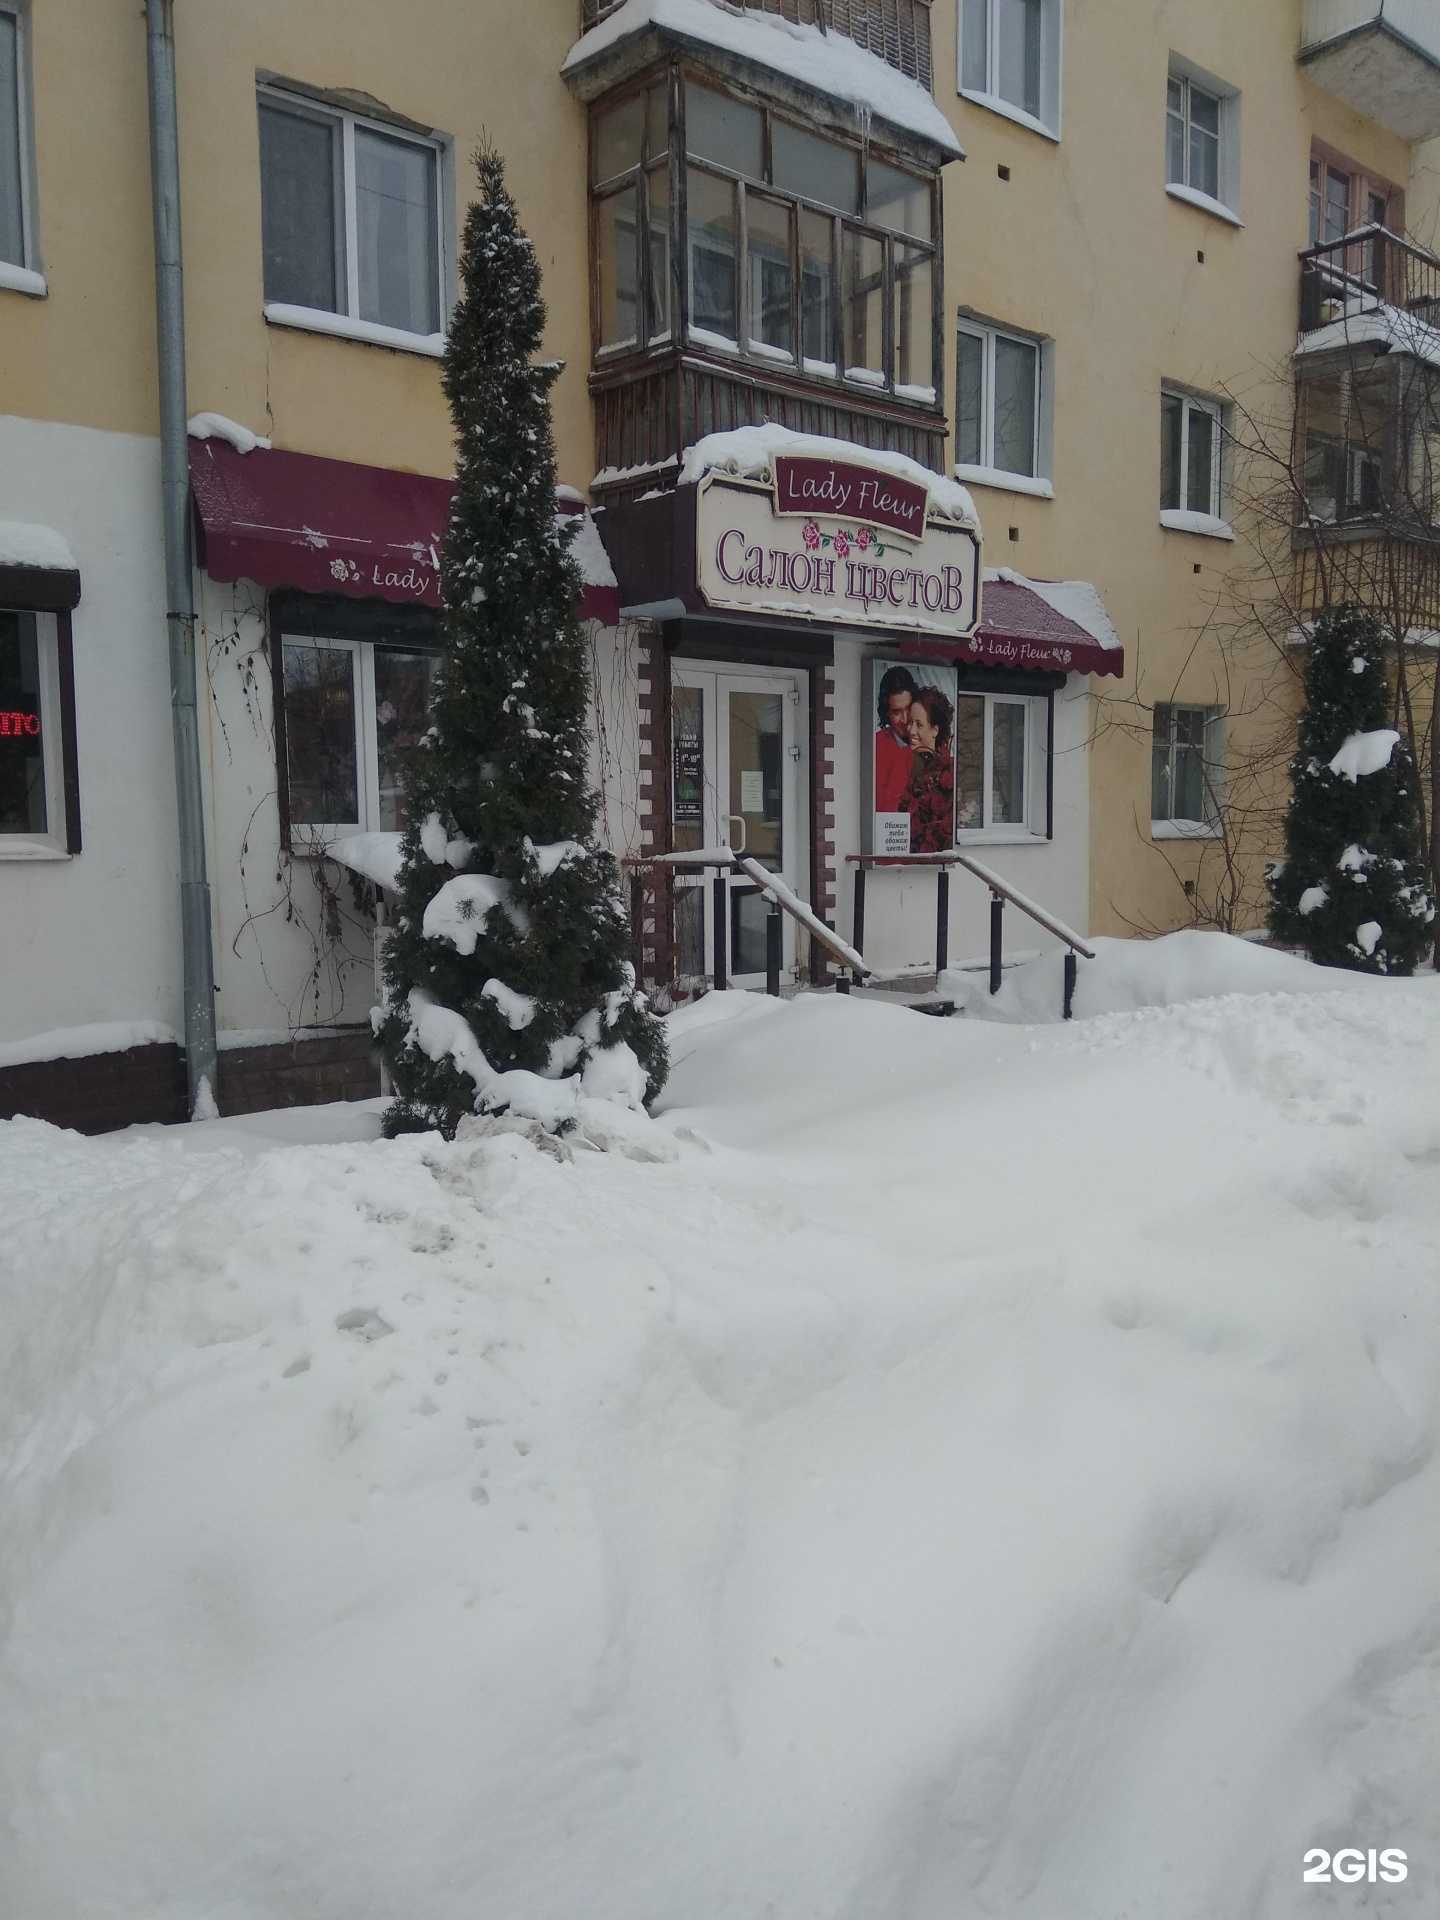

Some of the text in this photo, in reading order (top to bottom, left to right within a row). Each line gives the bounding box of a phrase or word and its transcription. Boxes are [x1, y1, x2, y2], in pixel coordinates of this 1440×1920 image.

[788, 468, 921, 520] Lady Fleur
[371, 564, 429, 595] Lady
[716, 529, 836, 595] Салон
[987, 639, 1051, 661] Lady Fleur
